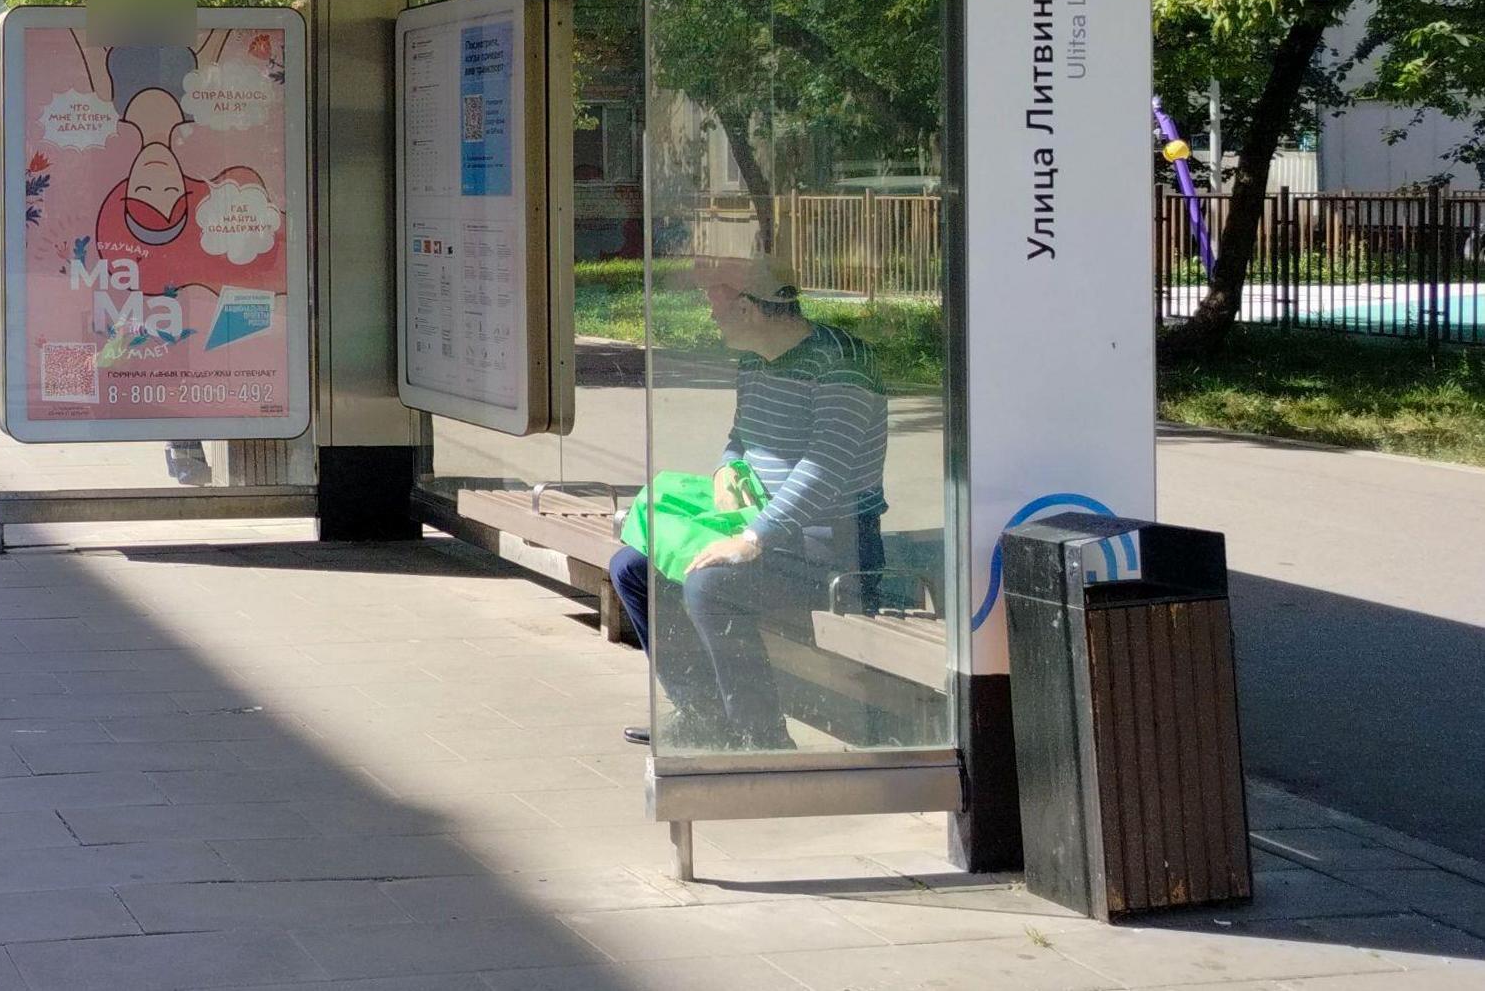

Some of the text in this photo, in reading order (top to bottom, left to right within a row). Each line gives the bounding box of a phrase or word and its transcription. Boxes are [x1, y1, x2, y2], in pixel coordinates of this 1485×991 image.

[1066, 14, 1086, 78] Ulitsa
[70, 104, 90, 112] ЧТО
[213, 102, 230, 112] ЛИ
[48, 113, 112, 122] МНЕ ТЕПЕРЬ
[57, 122, 103, 132] ДЕЛАТЬ?
[230, 204, 250, 213] ГДЕ
[1025, 147, 1059, 260] Улица
[222, 213, 258, 223] НАЙТИ
[97, 241, 150, 259] БУДУЩАЯ
[107, 370, 148, 379] ГОРЯЧАЯ
[107, 383, 275, 405] 8-800-2000-492
